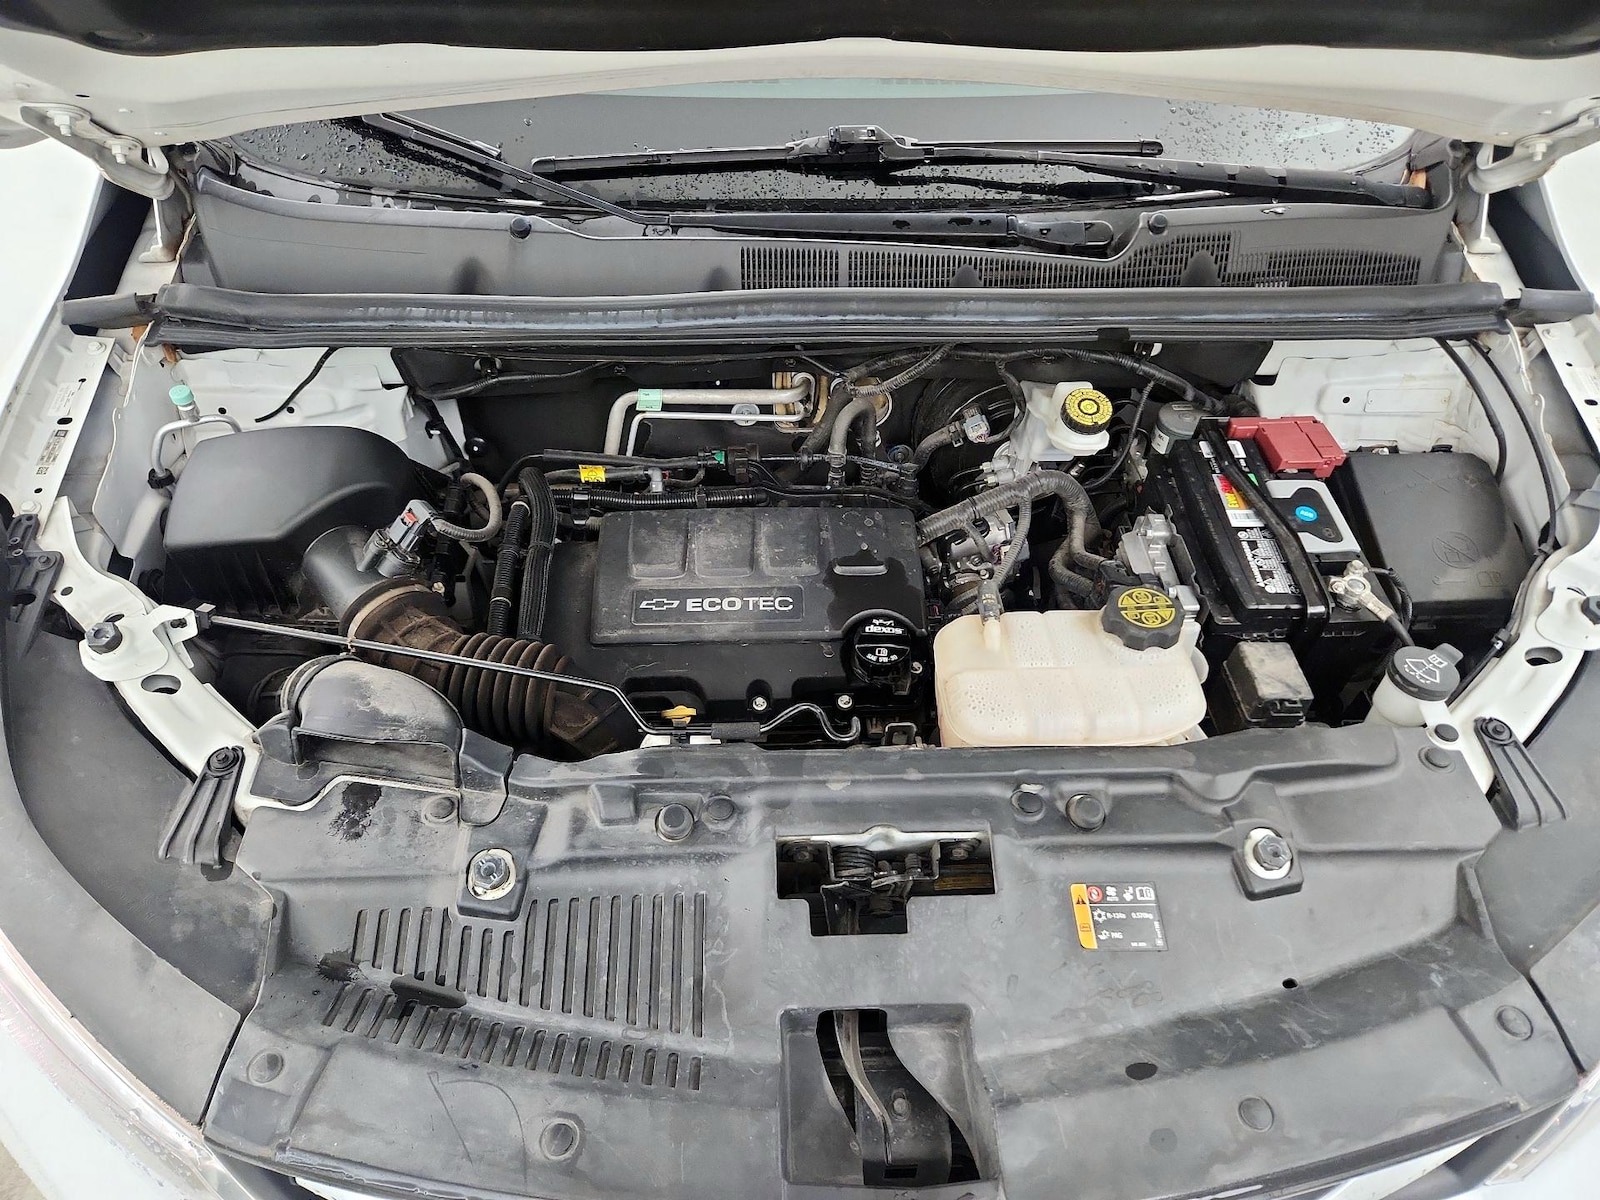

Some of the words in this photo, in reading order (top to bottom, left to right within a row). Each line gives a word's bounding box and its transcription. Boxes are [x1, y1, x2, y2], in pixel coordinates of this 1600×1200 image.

[686, 597, 794, 612] ECOTEC
[864, 624, 905, 635] dexos
[1110, 931, 1124, 939] PAG
